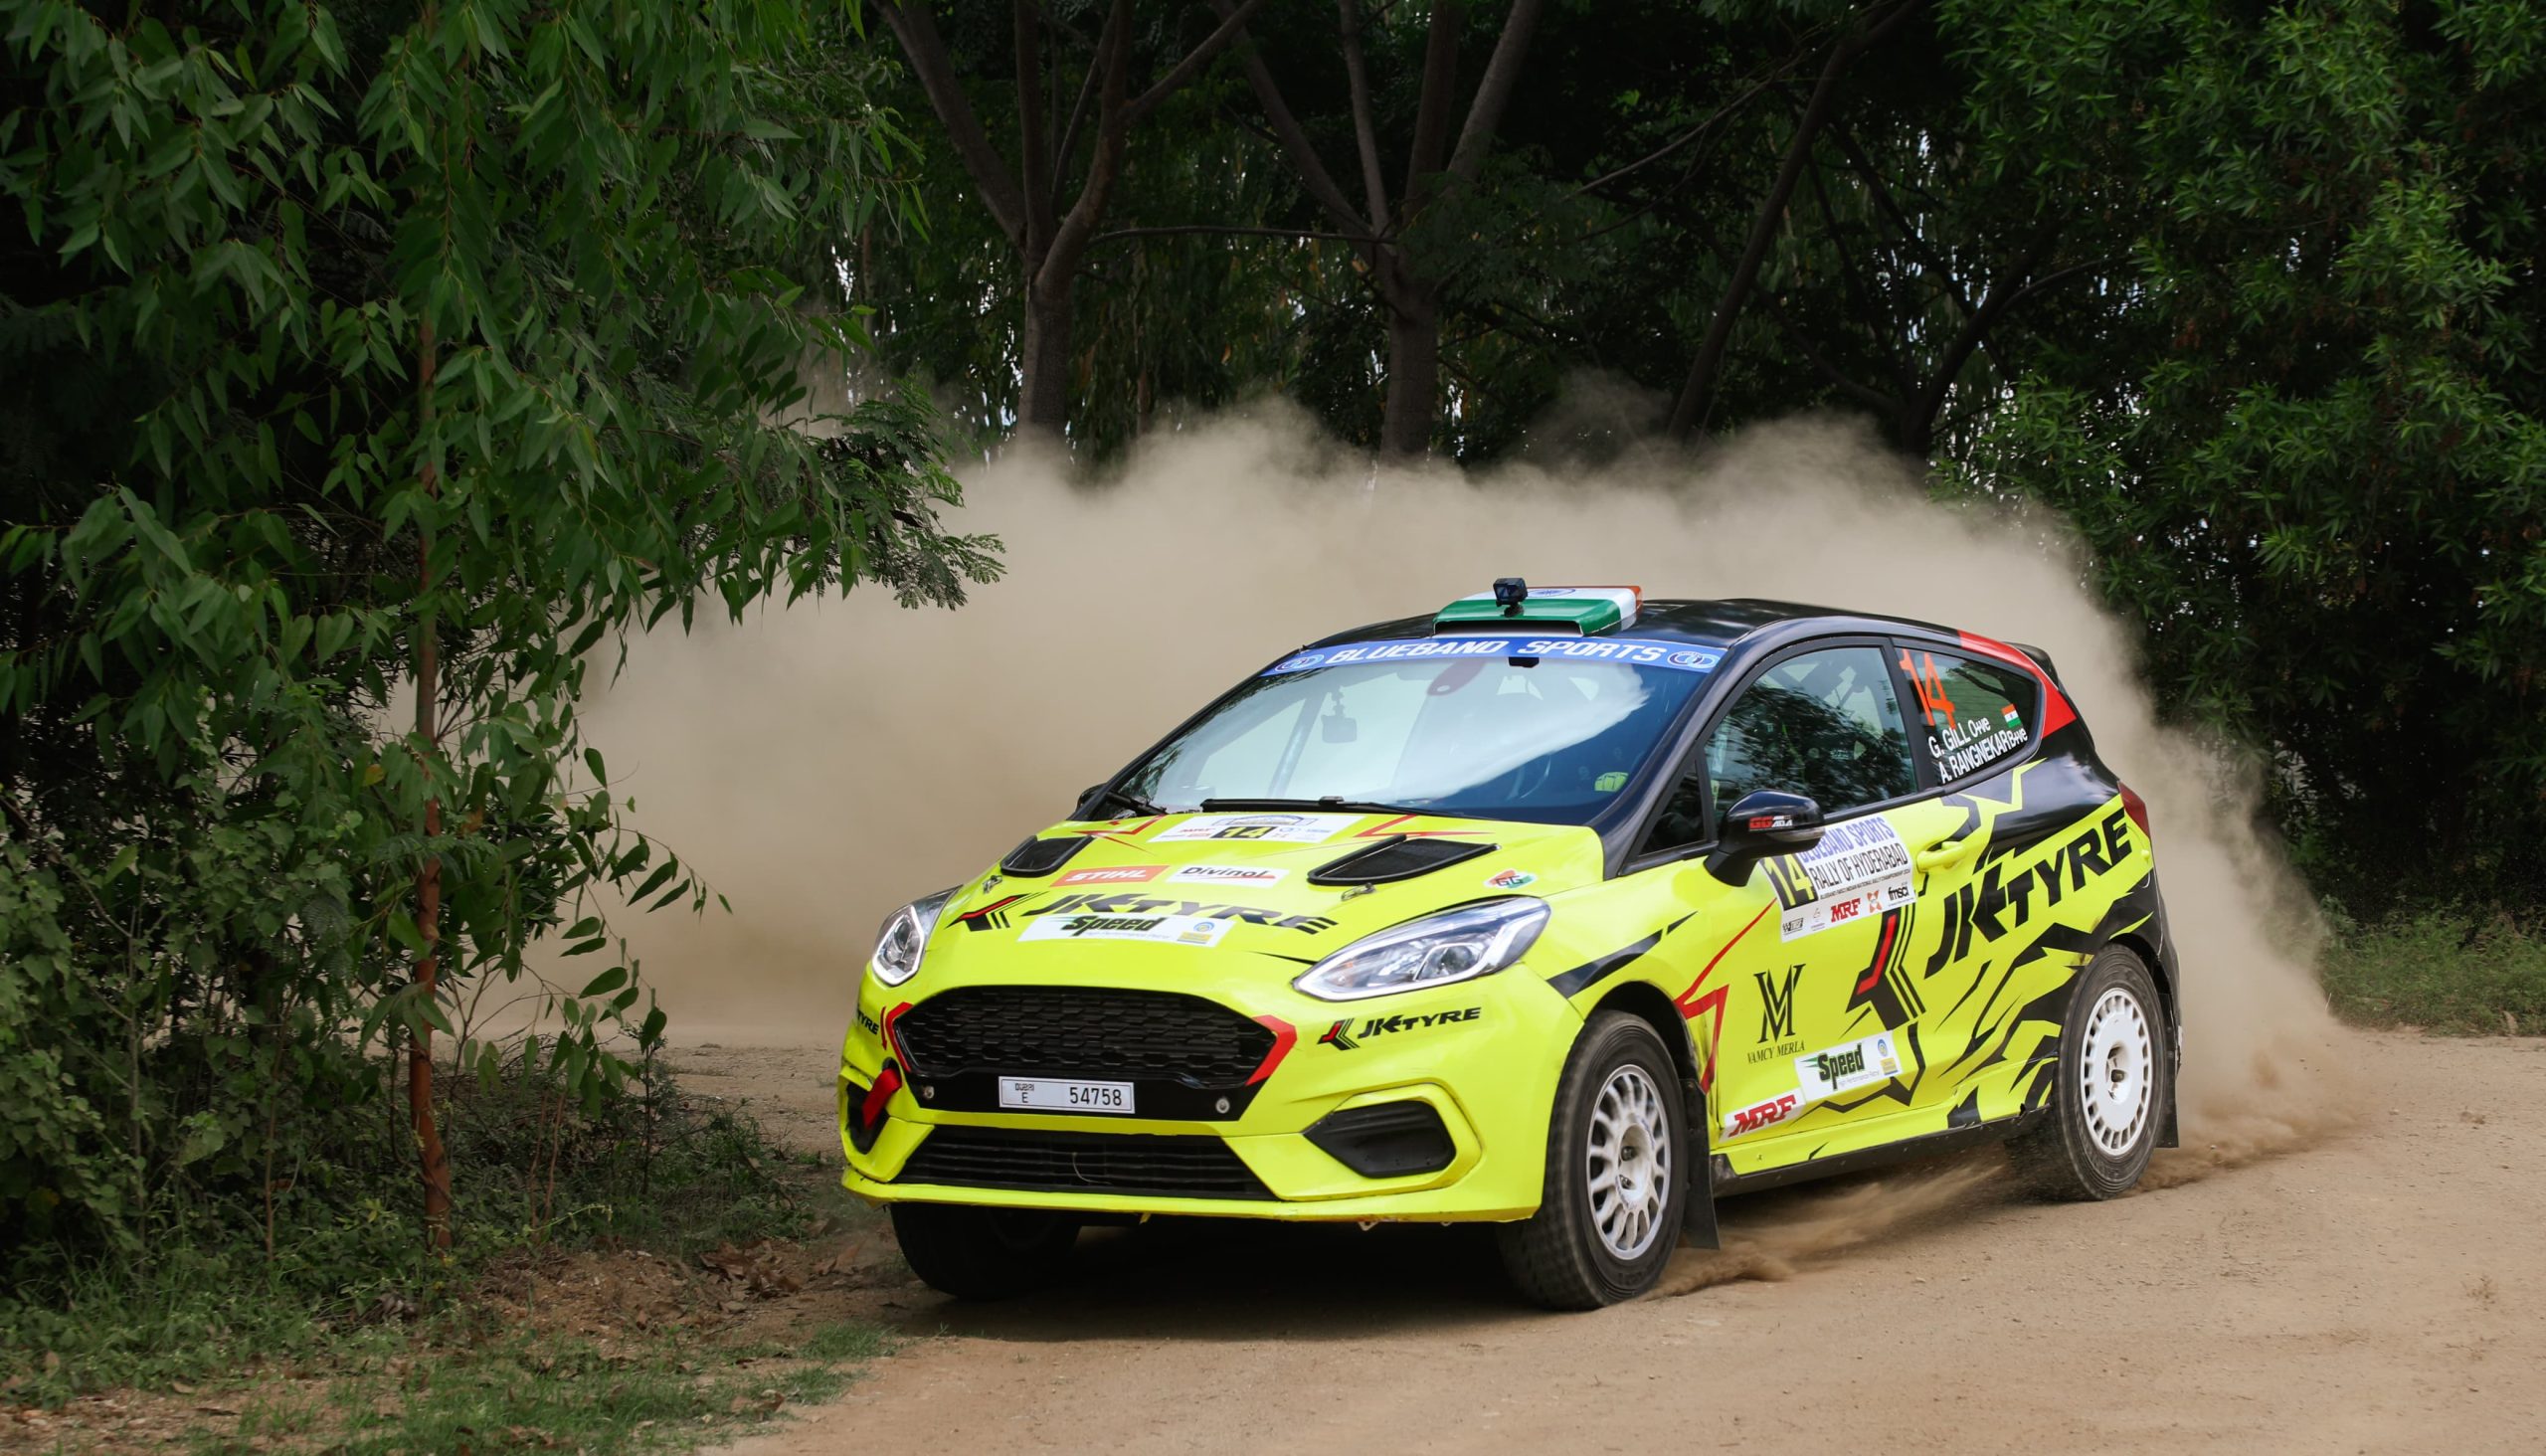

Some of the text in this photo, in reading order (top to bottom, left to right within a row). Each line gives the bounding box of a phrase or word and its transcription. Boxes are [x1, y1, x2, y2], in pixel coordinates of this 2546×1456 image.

[1325, 640, 1510, 664] BLUEBAND
[1517, 640, 1668, 662] SPORTS
[1900, 647, 1956, 730] 14
[1927, 735, 1945, 758] G.
[1941, 722, 1971, 751] GILL
[1938, 761, 1952, 784] A.
[1948, 729, 2011, 778] RANGNEKAR
[1222, 826, 1269, 838] 14
[1847, 817, 1896, 848] SPORTS
[1065, 867, 1149, 883] STIHL
[1181, 866, 1267, 877] Divinol
[1764, 853, 1815, 906] 14
[1809, 858, 1842, 890] RALLY
[1838, 856, 1854, 881] OF
[1852, 842, 1909, 878] HYDERABAD
[1831, 897, 1861, 923] MRF
[1060, 915, 1167, 937] Speed
[1747, 1040, 1805, 1065] VAMCY MERLA
[1817, 1042, 1865, 1091] Speed
[1021, 1086, 1122, 1106] E 54758
[1728, 1094, 1796, 1138] MRF
